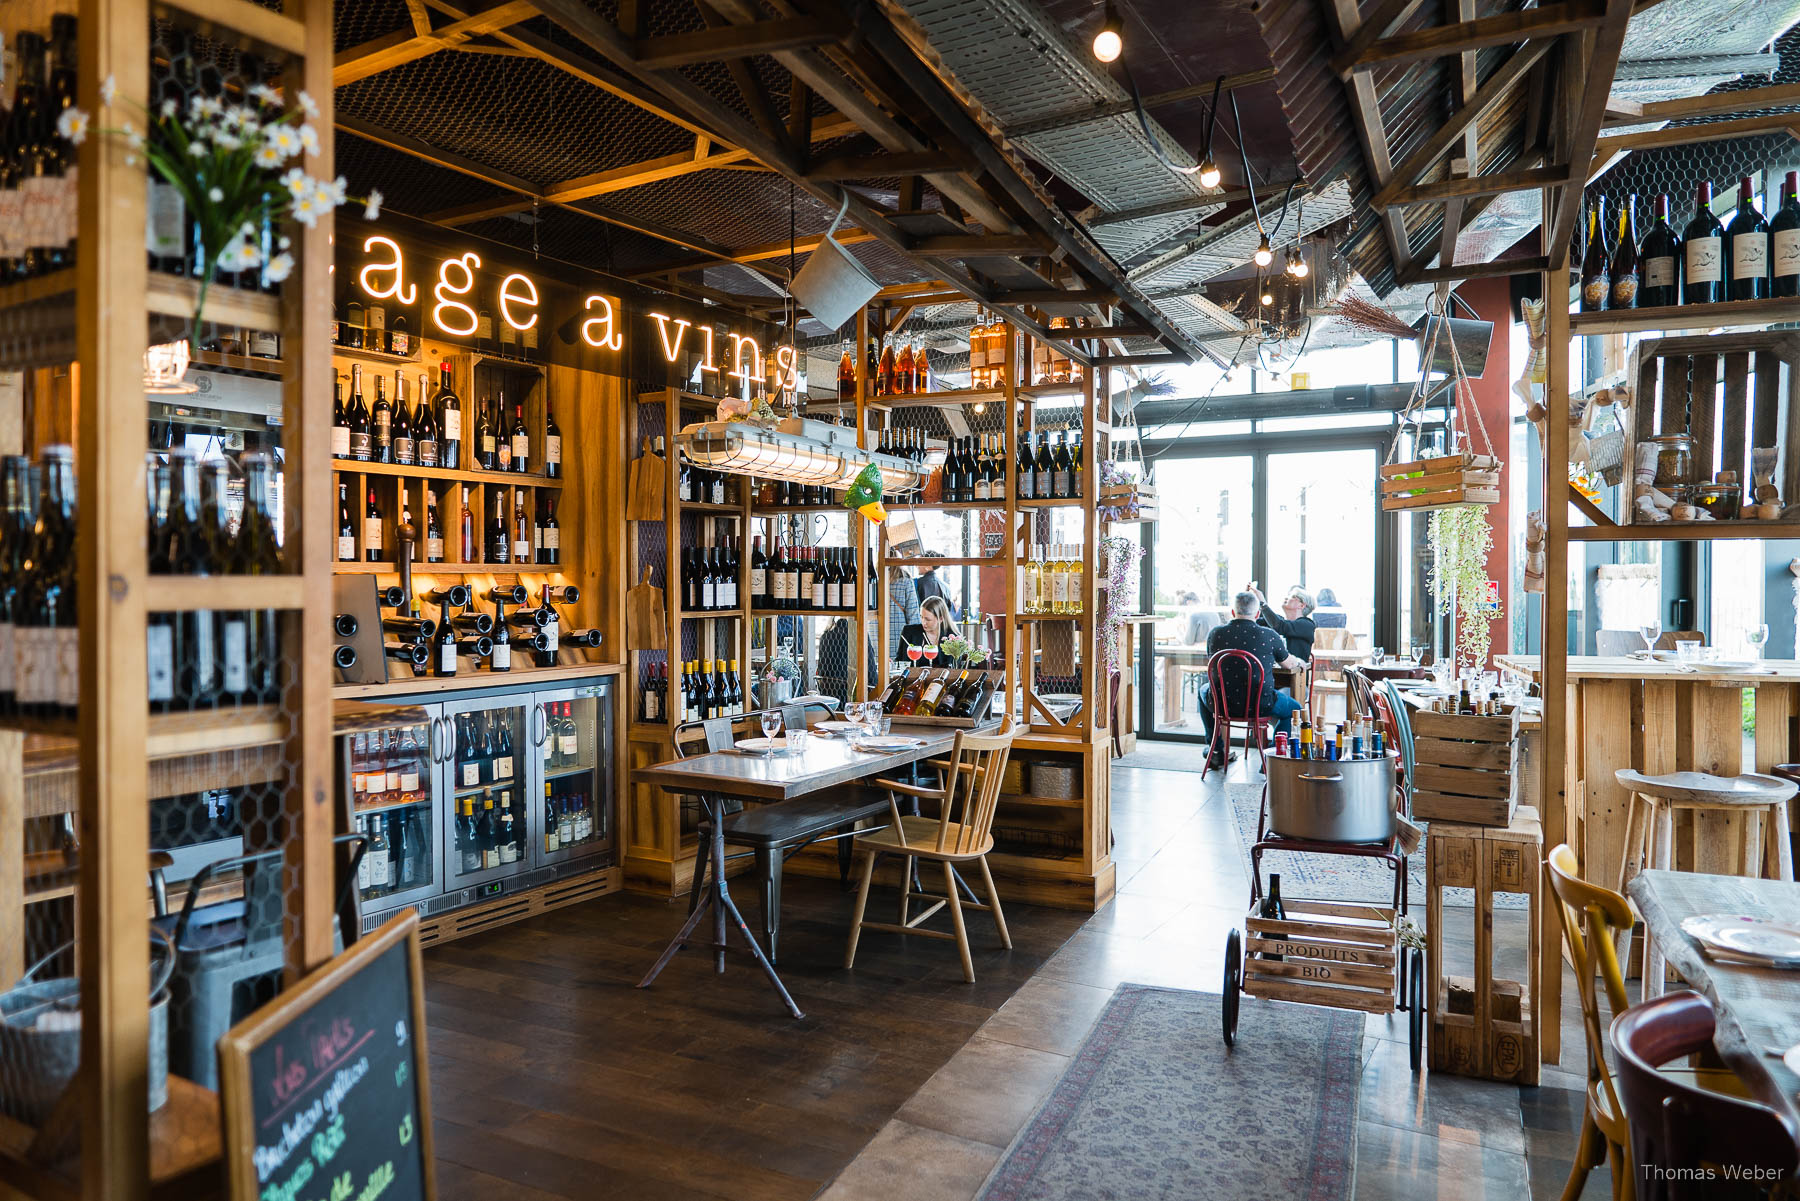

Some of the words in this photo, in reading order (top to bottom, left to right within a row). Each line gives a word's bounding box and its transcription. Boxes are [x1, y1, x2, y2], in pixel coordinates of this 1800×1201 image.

[329, 233, 539, 336] age
[581, 295, 623, 352] a
[1276, 943, 1359, 961] PRODUITS
[1302, 966, 1332, 979] BIO
